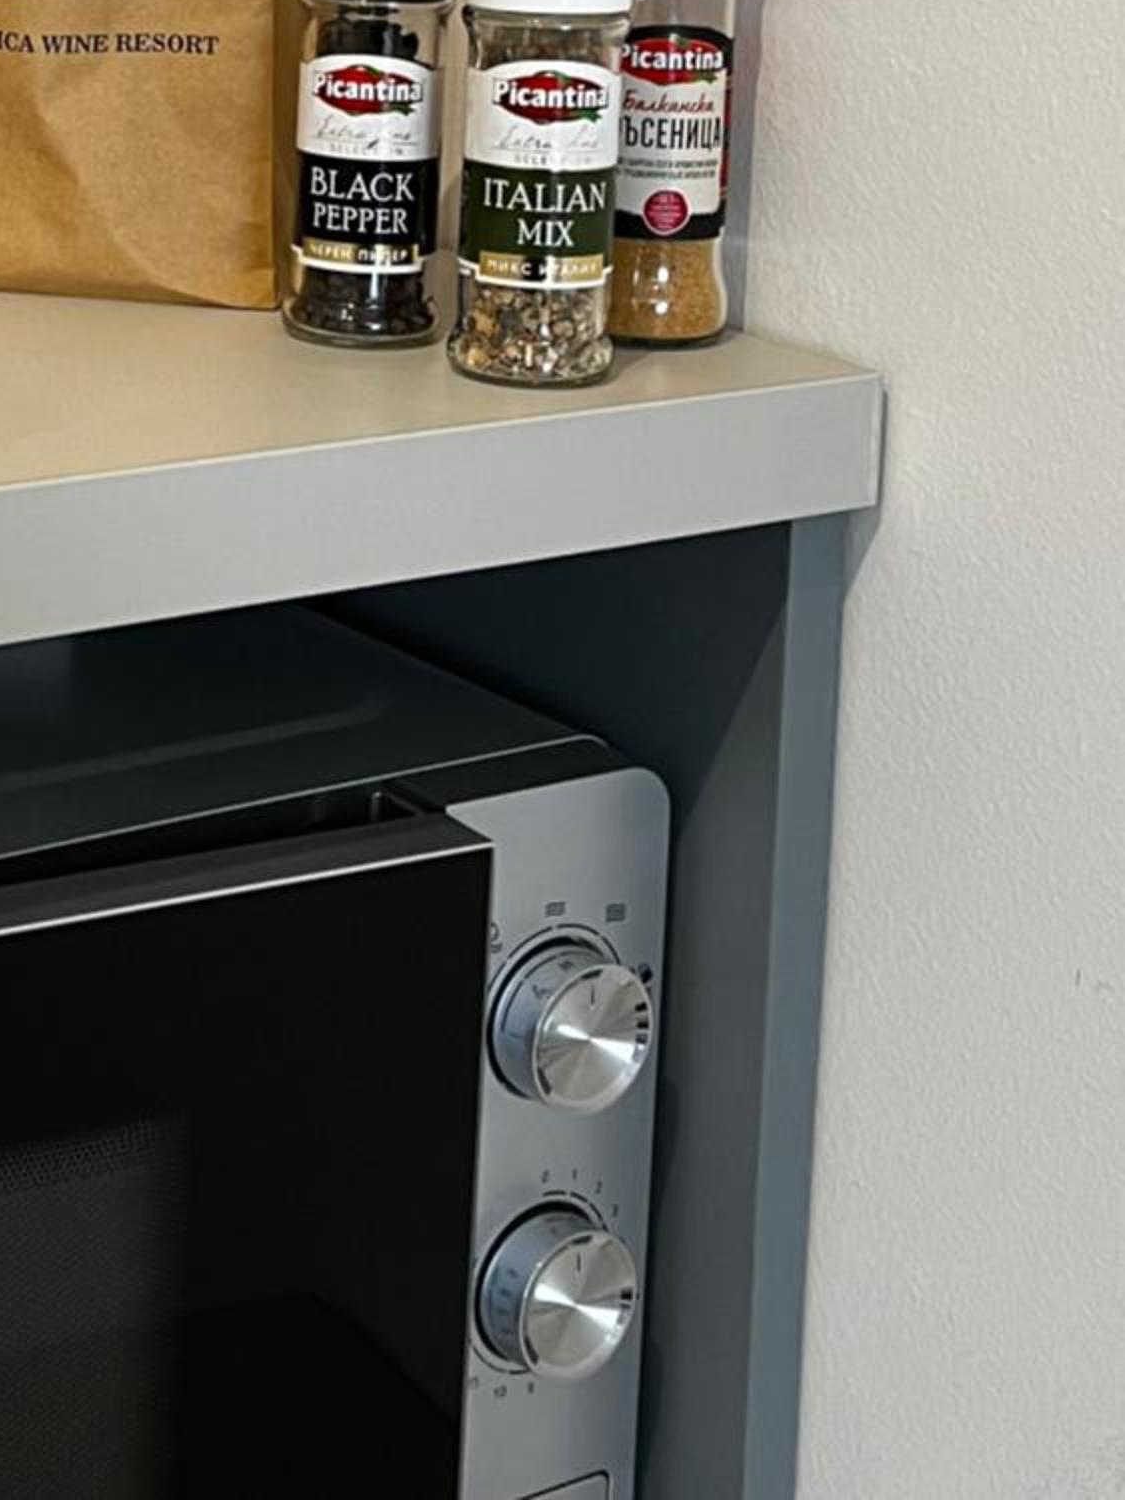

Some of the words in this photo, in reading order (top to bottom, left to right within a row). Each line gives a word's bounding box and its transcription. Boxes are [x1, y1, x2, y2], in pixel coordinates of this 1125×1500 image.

[42, 34, 109, 54] WINE
[116, 33, 220, 55] RESORT
[620, 43, 724, 71] Picantina
[314, 73, 424, 103] Picantina
[493, 78, 609, 109] Picantina
[310, 165, 415, 203] BLACK
[483, 177, 607, 213] ITALIAN
[313, 201, 409, 235] PEPPER
[517, 218, 574, 247] MIX
